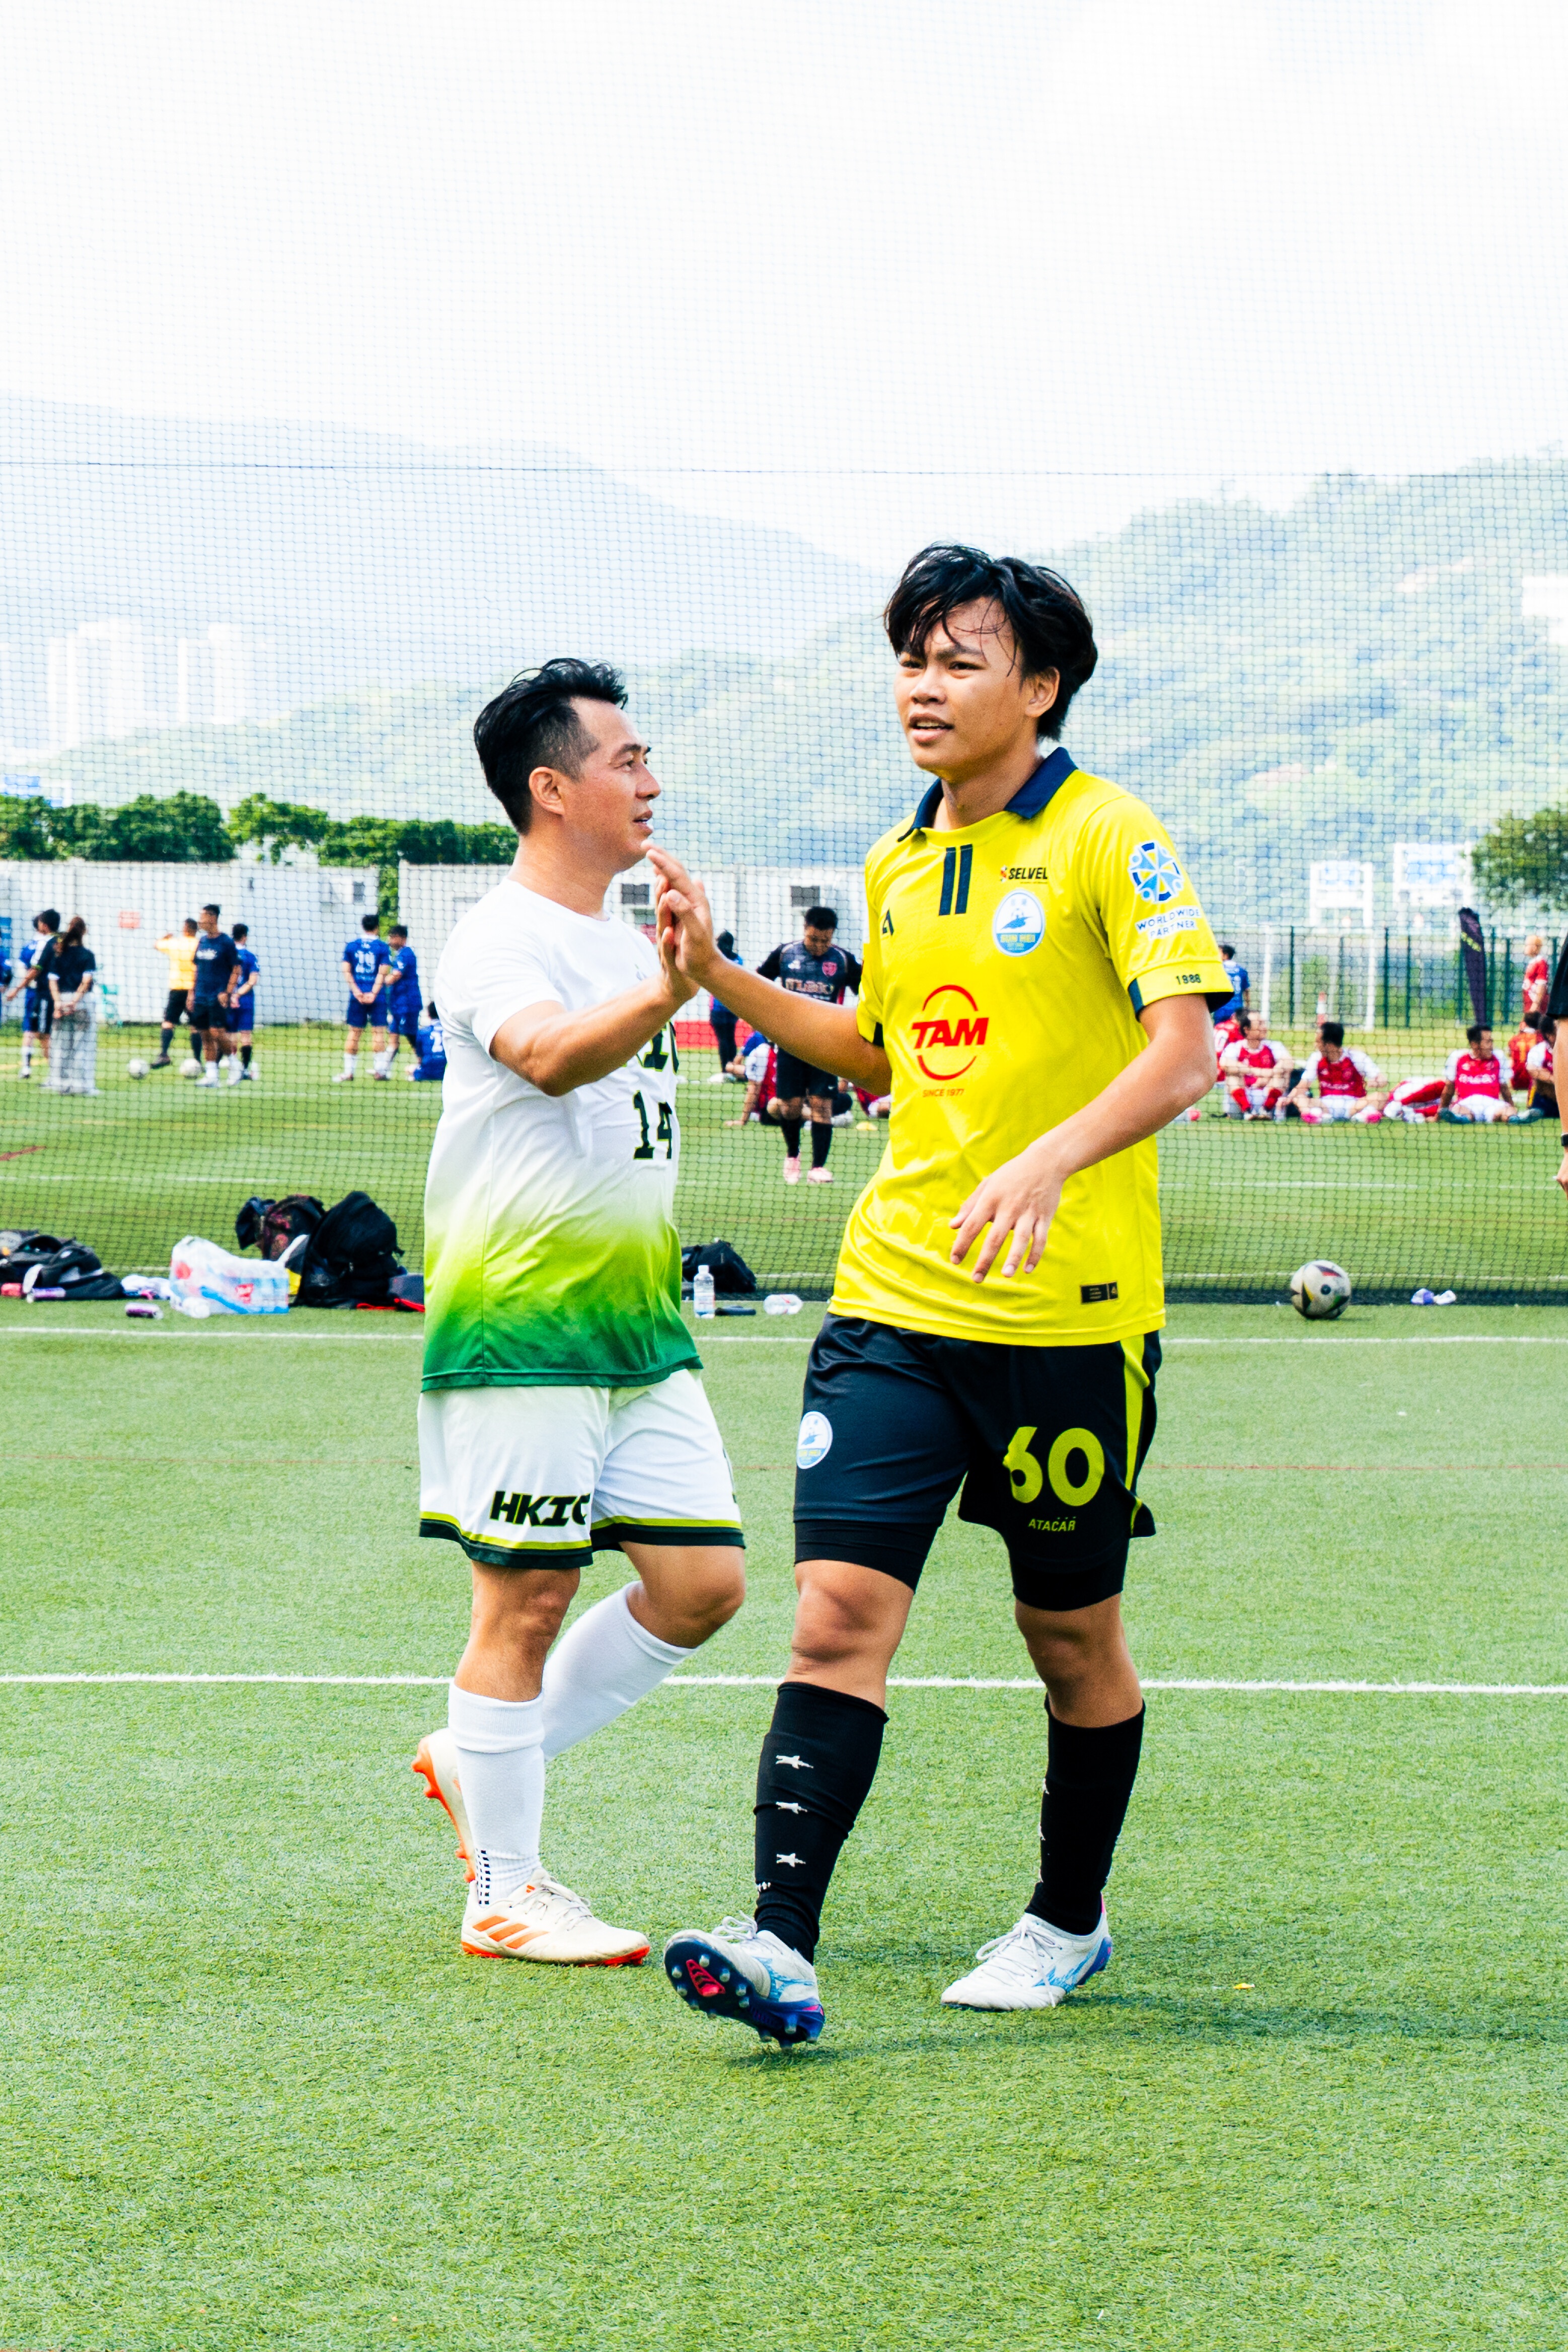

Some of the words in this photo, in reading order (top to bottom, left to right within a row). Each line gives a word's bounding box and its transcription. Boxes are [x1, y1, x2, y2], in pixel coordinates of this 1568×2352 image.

[1008, 867, 1048, 879] SELVEL
[1137, 908, 1200, 930] WORLDWIDE
[1150, 920, 1195, 936] PARTNER
[911, 1017, 989, 1050] TAM
[923, 1089, 944, 1097] SINCE
[947, 1088, 964, 1096] 1977
[632, 1089, 673, 1160] 14
[1002, 1426, 1105, 1507] 60
